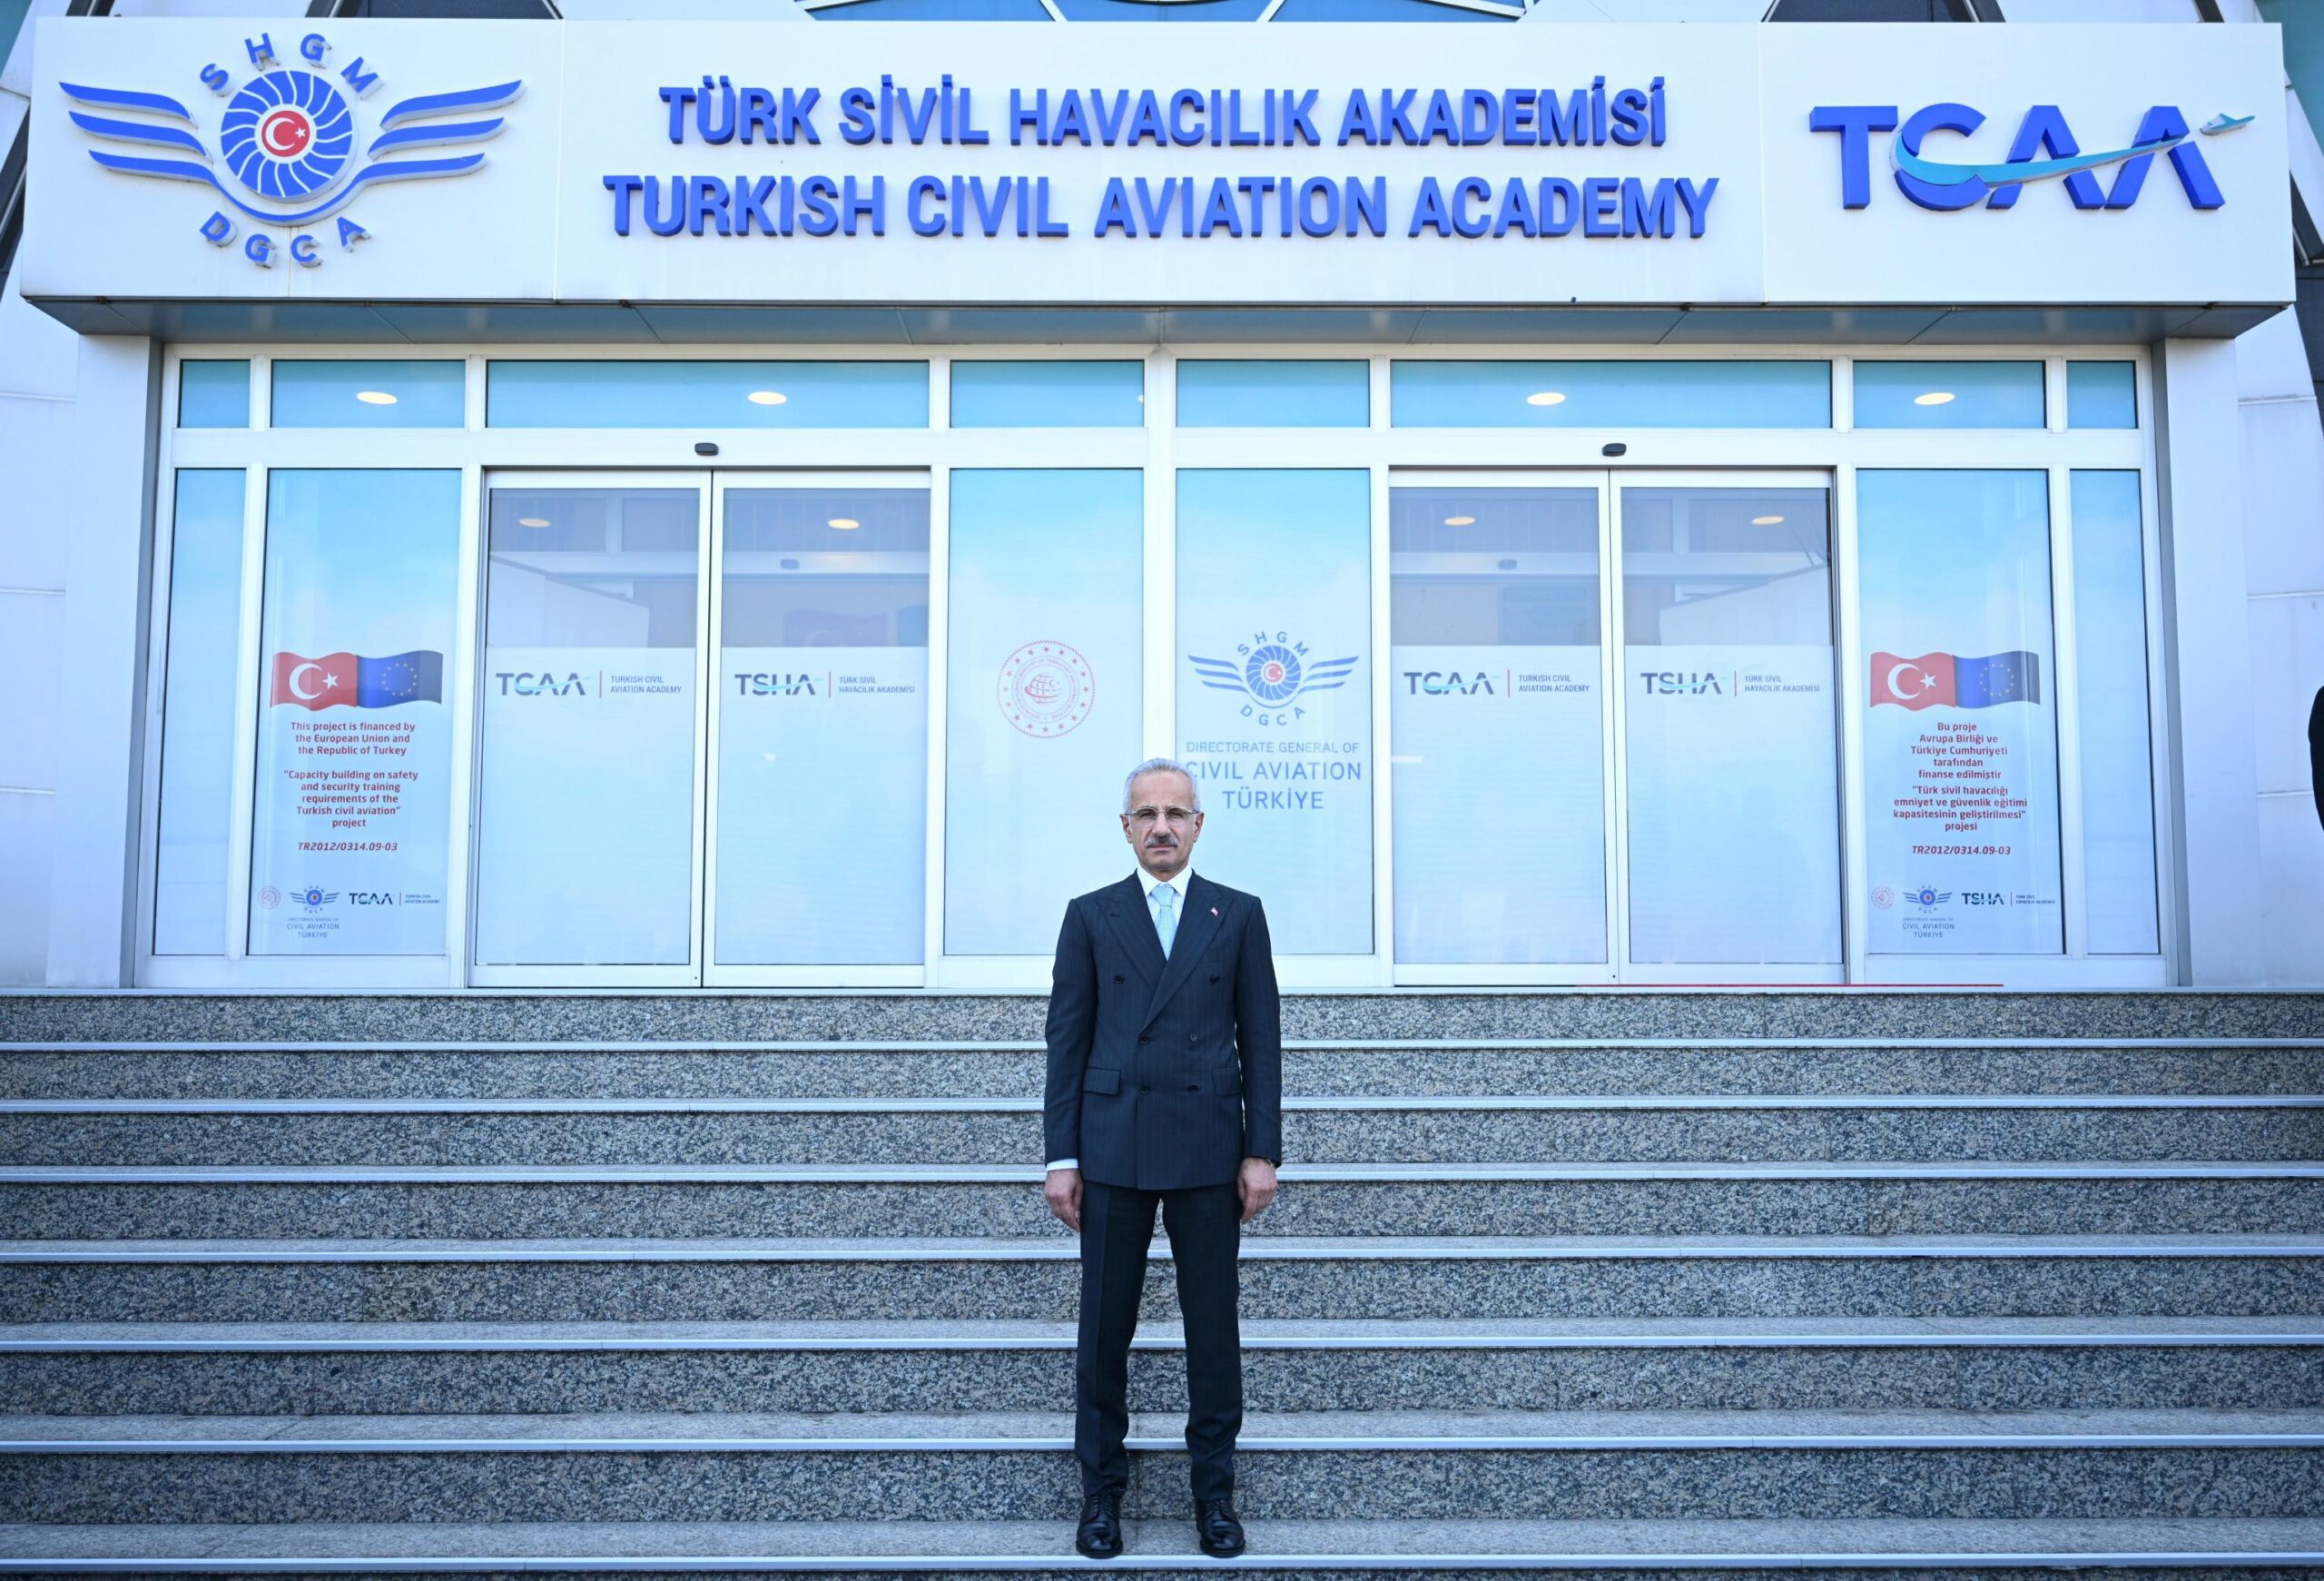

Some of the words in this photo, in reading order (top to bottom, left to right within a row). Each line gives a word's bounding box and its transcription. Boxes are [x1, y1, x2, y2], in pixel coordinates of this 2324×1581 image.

[660, 76, 821, 145] TÜRK
[839, 76, 989, 145] SİVİL
[1009, 89, 1321, 148] HAVACILIK
[1338, 77, 1667, 148] AKADEMİSİ
[1809, 103, 2225, 212] TCAA
[604, 175, 886, 237] TURKISH
[907, 175, 1068, 237] CIVIL
[1095, 177, 1387, 237] AVIATION
[1409, 177, 1718, 239] ACADEMY
[496, 673, 586, 696] TCAA
[734, 674, 815, 696] TSHA
[1404, 672, 1493, 695] TCAA
[1640, 672, 1721, 695] TSHA
[291, 722, 310, 730] This
[313, 723, 346, 732] project
[404, 723, 415, 732] by
[1938, 722, 1949, 730] Bu
[1953, 723, 1976, 732] proje
[314, 735, 359, 744] European
[1920, 735, 1953, 744] Avrupa
[1956, 735, 1984, 745] Birliği
[317, 746, 358, 756] Republic
[374, 746, 407, 756] Turkey
[1187, 742, 1273, 752] DIRECTORATE
[1279, 743, 1337, 753] GENERAL
[1343, 743, 1359, 753] OF
[1911, 746, 1946, 756] Türkiye
[1950, 746, 2007, 756] Cumhuriyeti
[1934, 758, 1983, 766] tarafından
[332, 771, 370, 780] building
[388, 771, 419, 780] safety
[1254, 763, 1361, 779] AVIATION
[1919, 770, 1954, 778] finanse
[1957, 770, 2001, 780] edilmiştir
[321, 784, 359, 792] security
[363, 784, 400, 792] training
[1941, 786, 1960, 795] sivil
[1964, 786, 2008, 796] havacılığı
[302, 795, 367, 804] requirements
[1223, 786, 1323, 808] TÜRKİYE
[1895, 798, 1933, 807] emniyet
[1950, 798, 1991, 807] güvenlik
[1994, 798, 2027, 807] eğitimi
[297, 806, 331, 815] Turkish
[335, 806, 354, 815] civil
[1894, 811, 1956, 820] kapasitesinin
[332, 819, 366, 828] project
[1945, 823, 1977, 832] projesi
[299, 843, 398, 851] TR2012/0314.09-03
[1912, 846, 2011, 855] TR2012/0314.09-03
[349, 893, 392, 904] TCAA
[1962, 893, 2004, 904] TSHA
